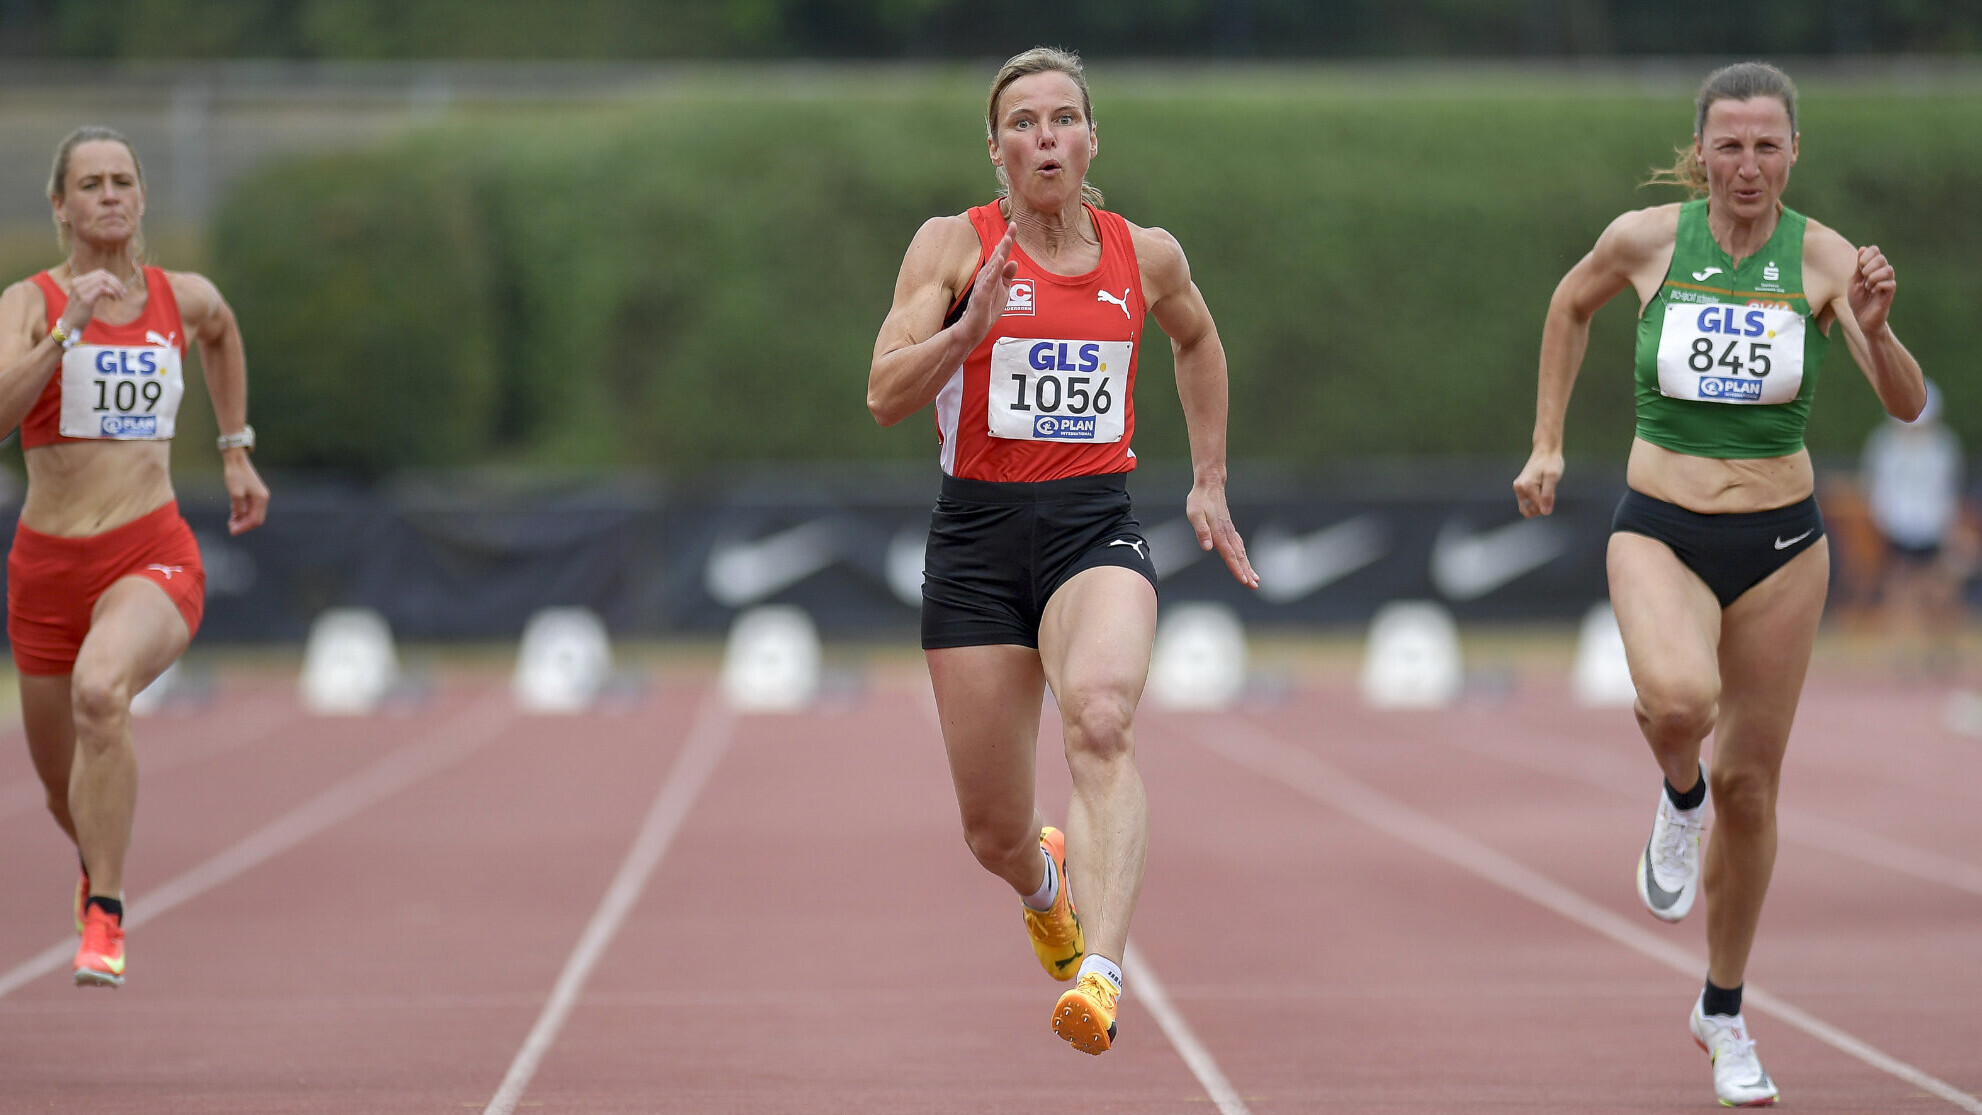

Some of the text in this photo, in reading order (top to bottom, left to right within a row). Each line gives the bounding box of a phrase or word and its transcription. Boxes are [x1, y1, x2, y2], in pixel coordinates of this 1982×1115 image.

[1688, 337, 1772, 378] 845
[93, 380, 162, 412] 109
[1010, 373, 1112, 415] 1056
[1724, 380, 1760, 395] PLAN
[1060, 419, 1094, 431] PLAN
